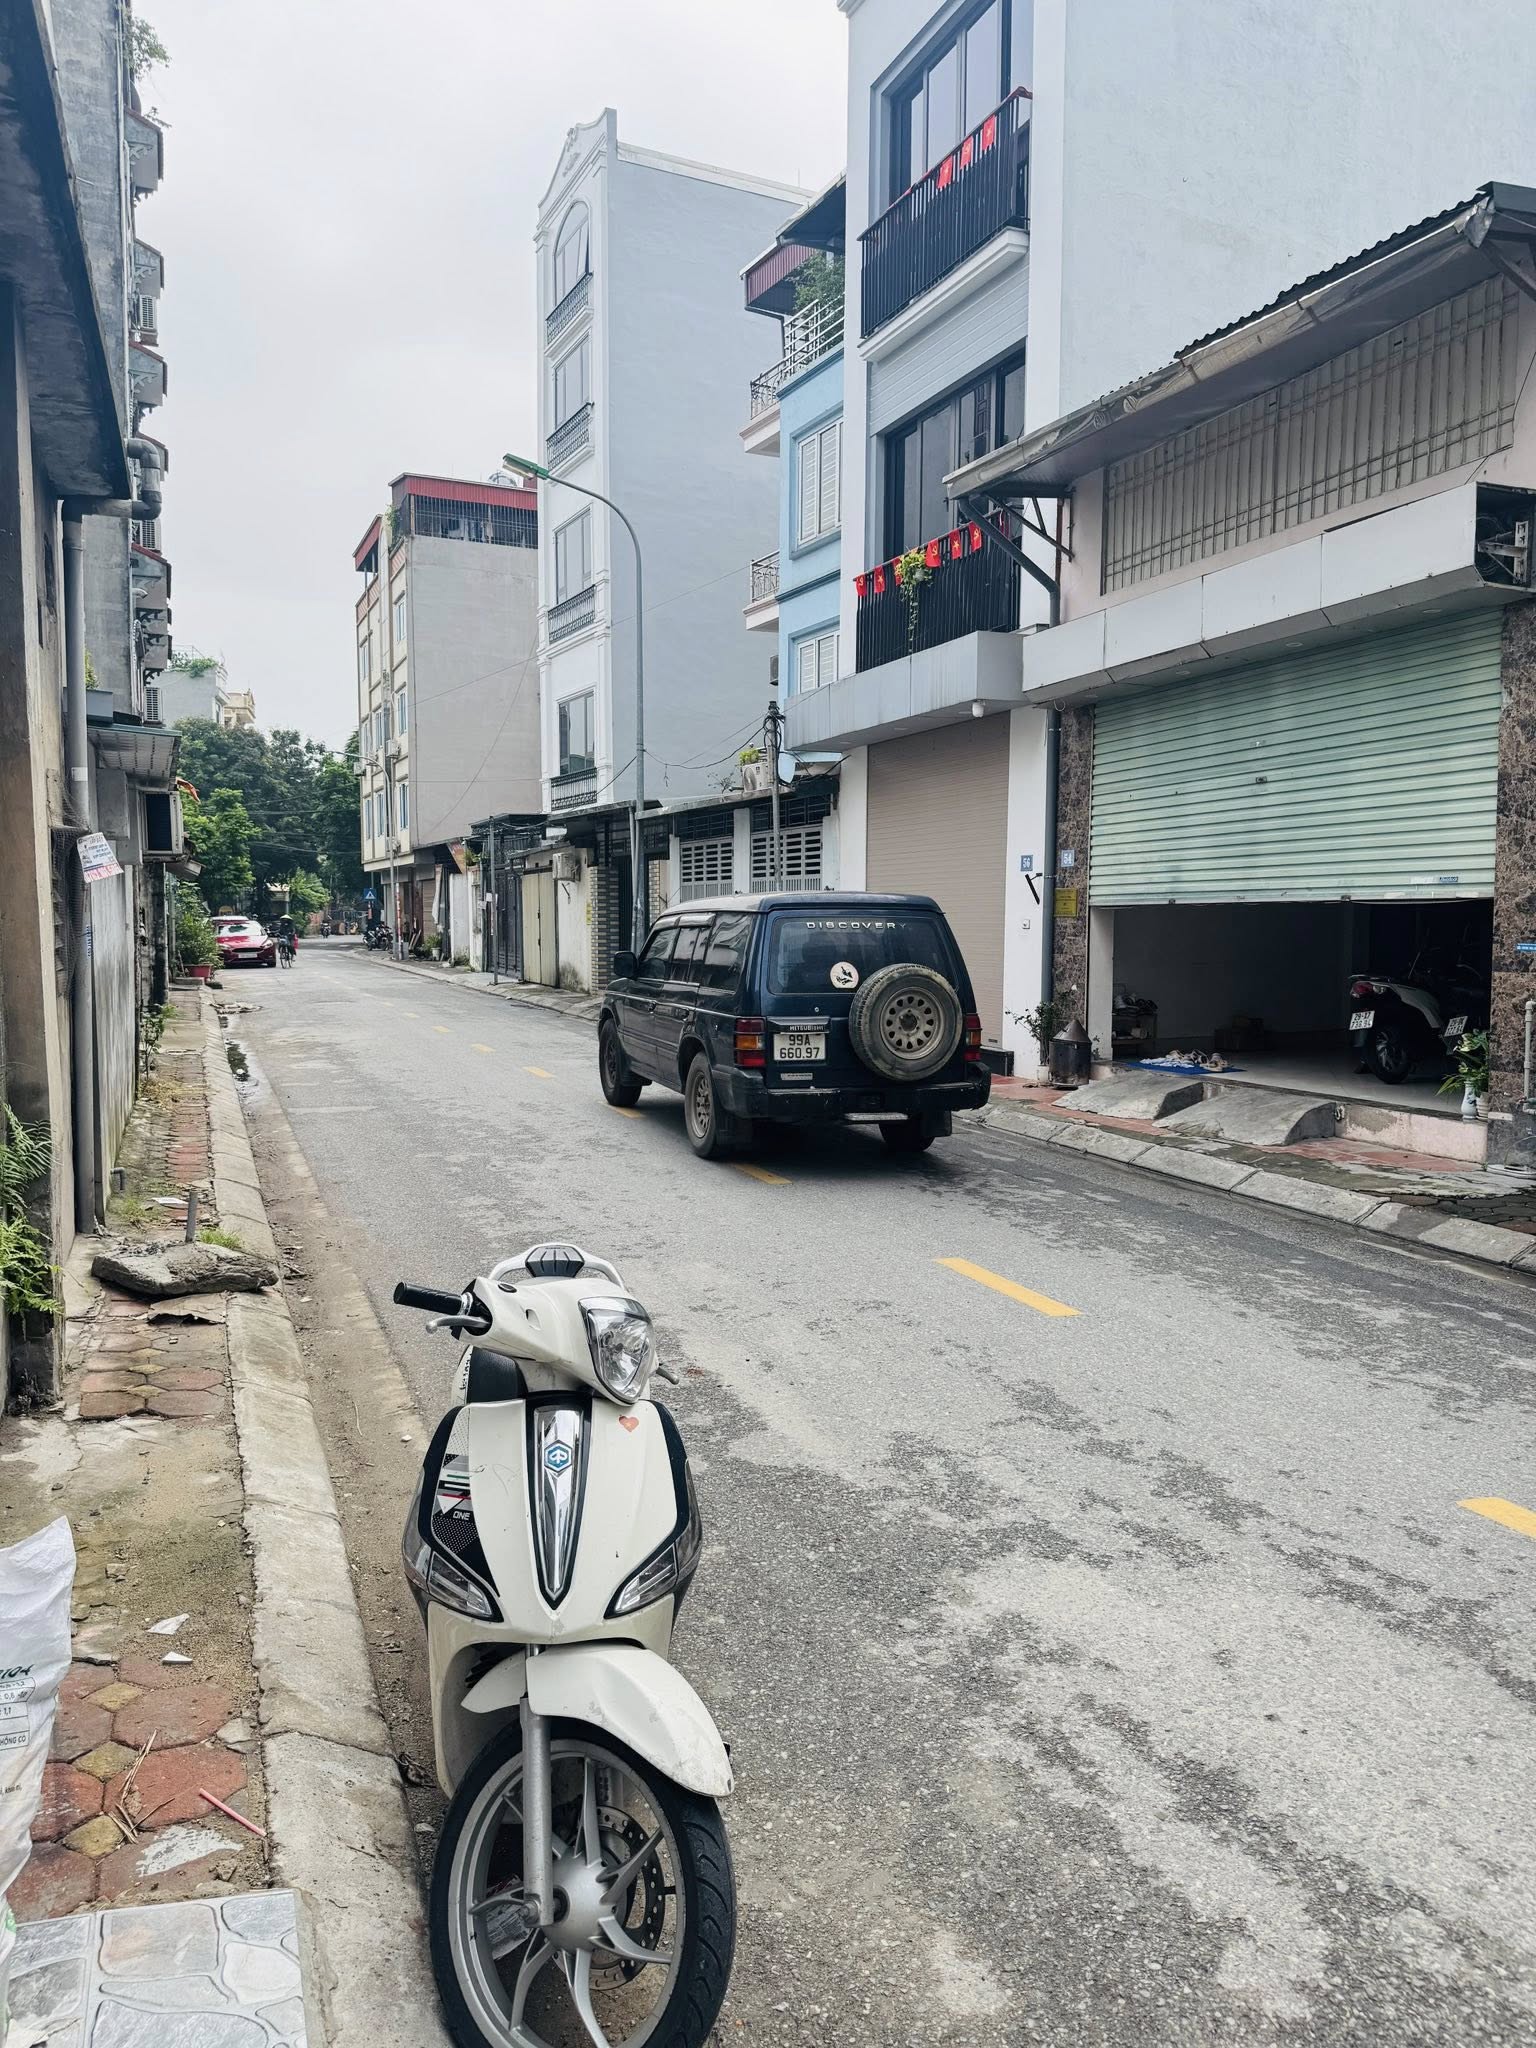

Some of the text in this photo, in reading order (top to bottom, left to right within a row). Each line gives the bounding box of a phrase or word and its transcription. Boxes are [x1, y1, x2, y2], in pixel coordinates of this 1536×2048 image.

[1022, 857, 1031, 868] 56
[788, 1034, 811, 1046] 99A
[779, 1047, 820, 1059] 660.97
[453, 1510, 471, 1521] ONE
[0, 1735, 17, 1746] HÔNG
